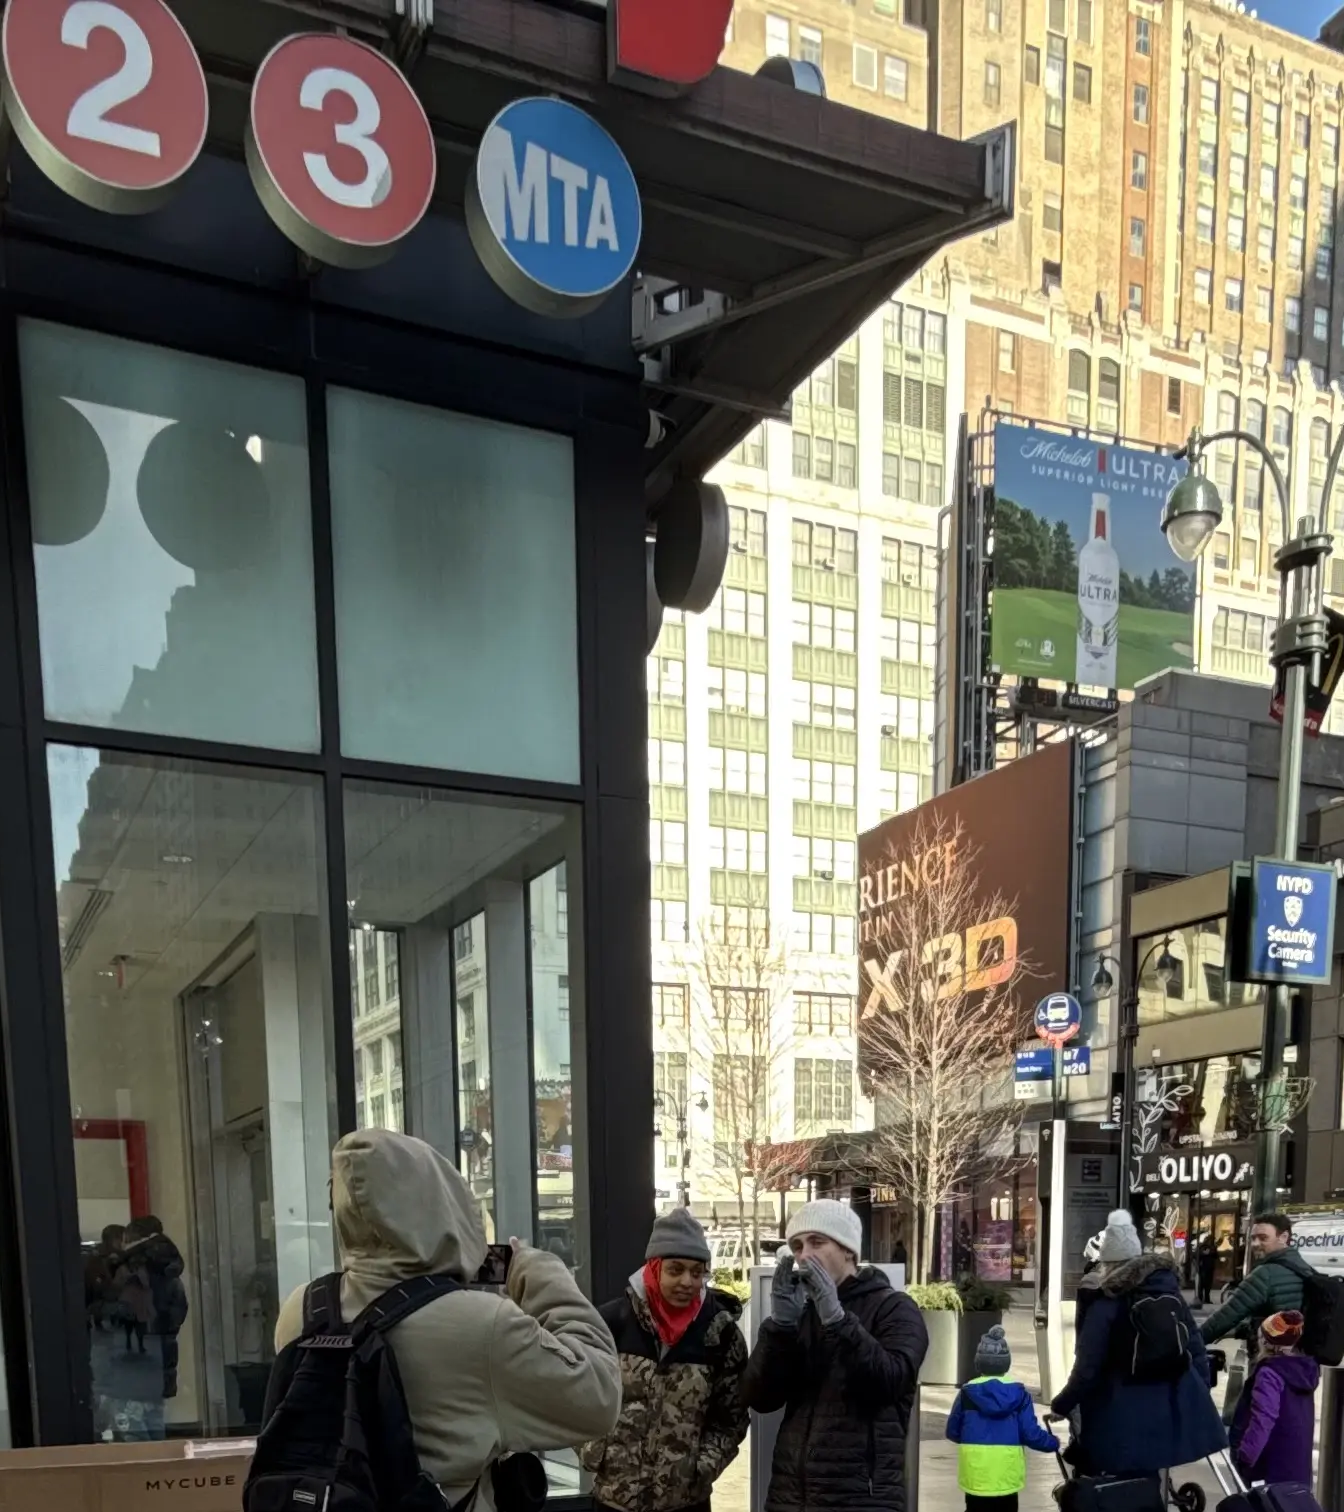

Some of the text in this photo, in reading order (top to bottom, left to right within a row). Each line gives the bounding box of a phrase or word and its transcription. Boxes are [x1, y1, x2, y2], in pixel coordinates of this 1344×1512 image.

[61, 0, 161, 157] 2
[299, 66, 392, 209] 3
[478, 126, 619, 251] MTA
[1020, 436, 1181, 485] Michelob ULTRA
[1032, 464, 1164, 500] SUPERIOR LIGHT BEE
[1080, 583, 1117, 601] ULTRA
[1277, 875, 1313, 895] NYPD
[1268, 925, 1316, 948] Security
[921, 917, 1018, 1002] 3D
[1268, 943, 1314, 963] Camera
[1161, 1153, 1232, 1184] OLIYO
[870, 1186, 896, 1203] PINK
[146, 1475, 236, 1491] MYCUBE
